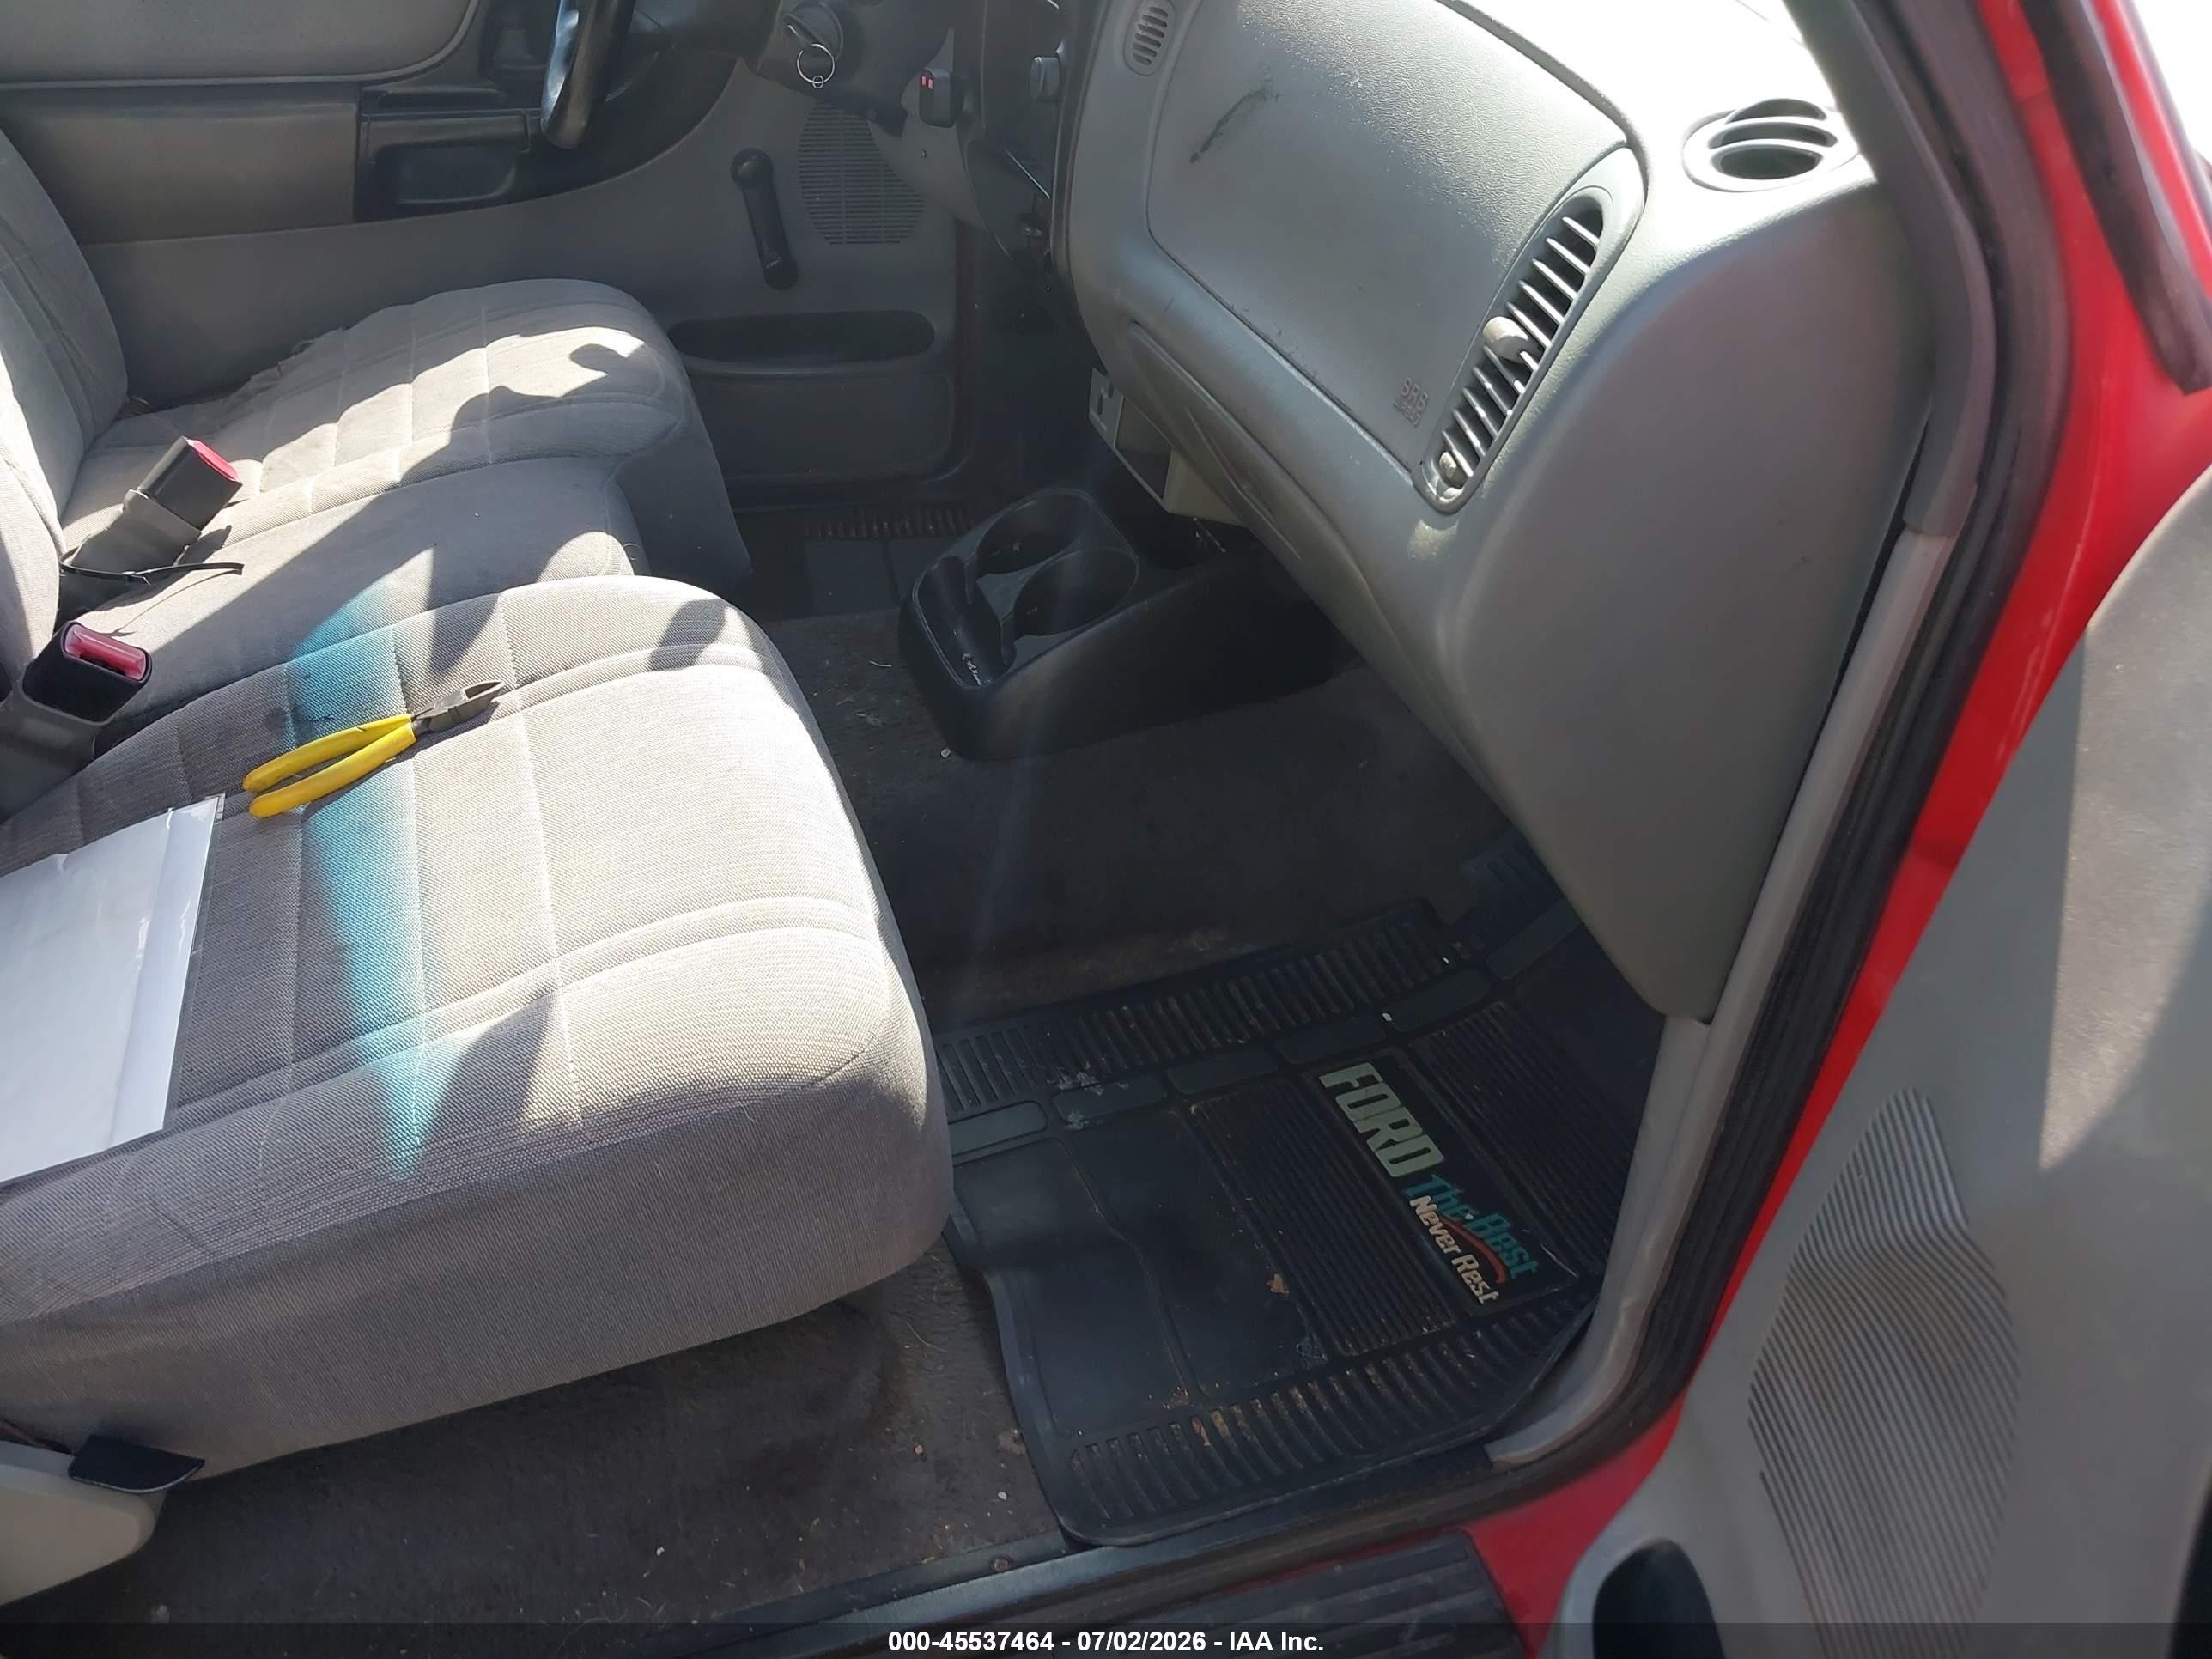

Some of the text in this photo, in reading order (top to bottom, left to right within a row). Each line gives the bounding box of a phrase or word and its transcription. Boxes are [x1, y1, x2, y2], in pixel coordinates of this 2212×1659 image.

[1319, 1062, 1444, 1178] FORD
[1401, 1174, 1539, 1279] The Best
[1409, 1194, 1499, 1305] Never Rest
